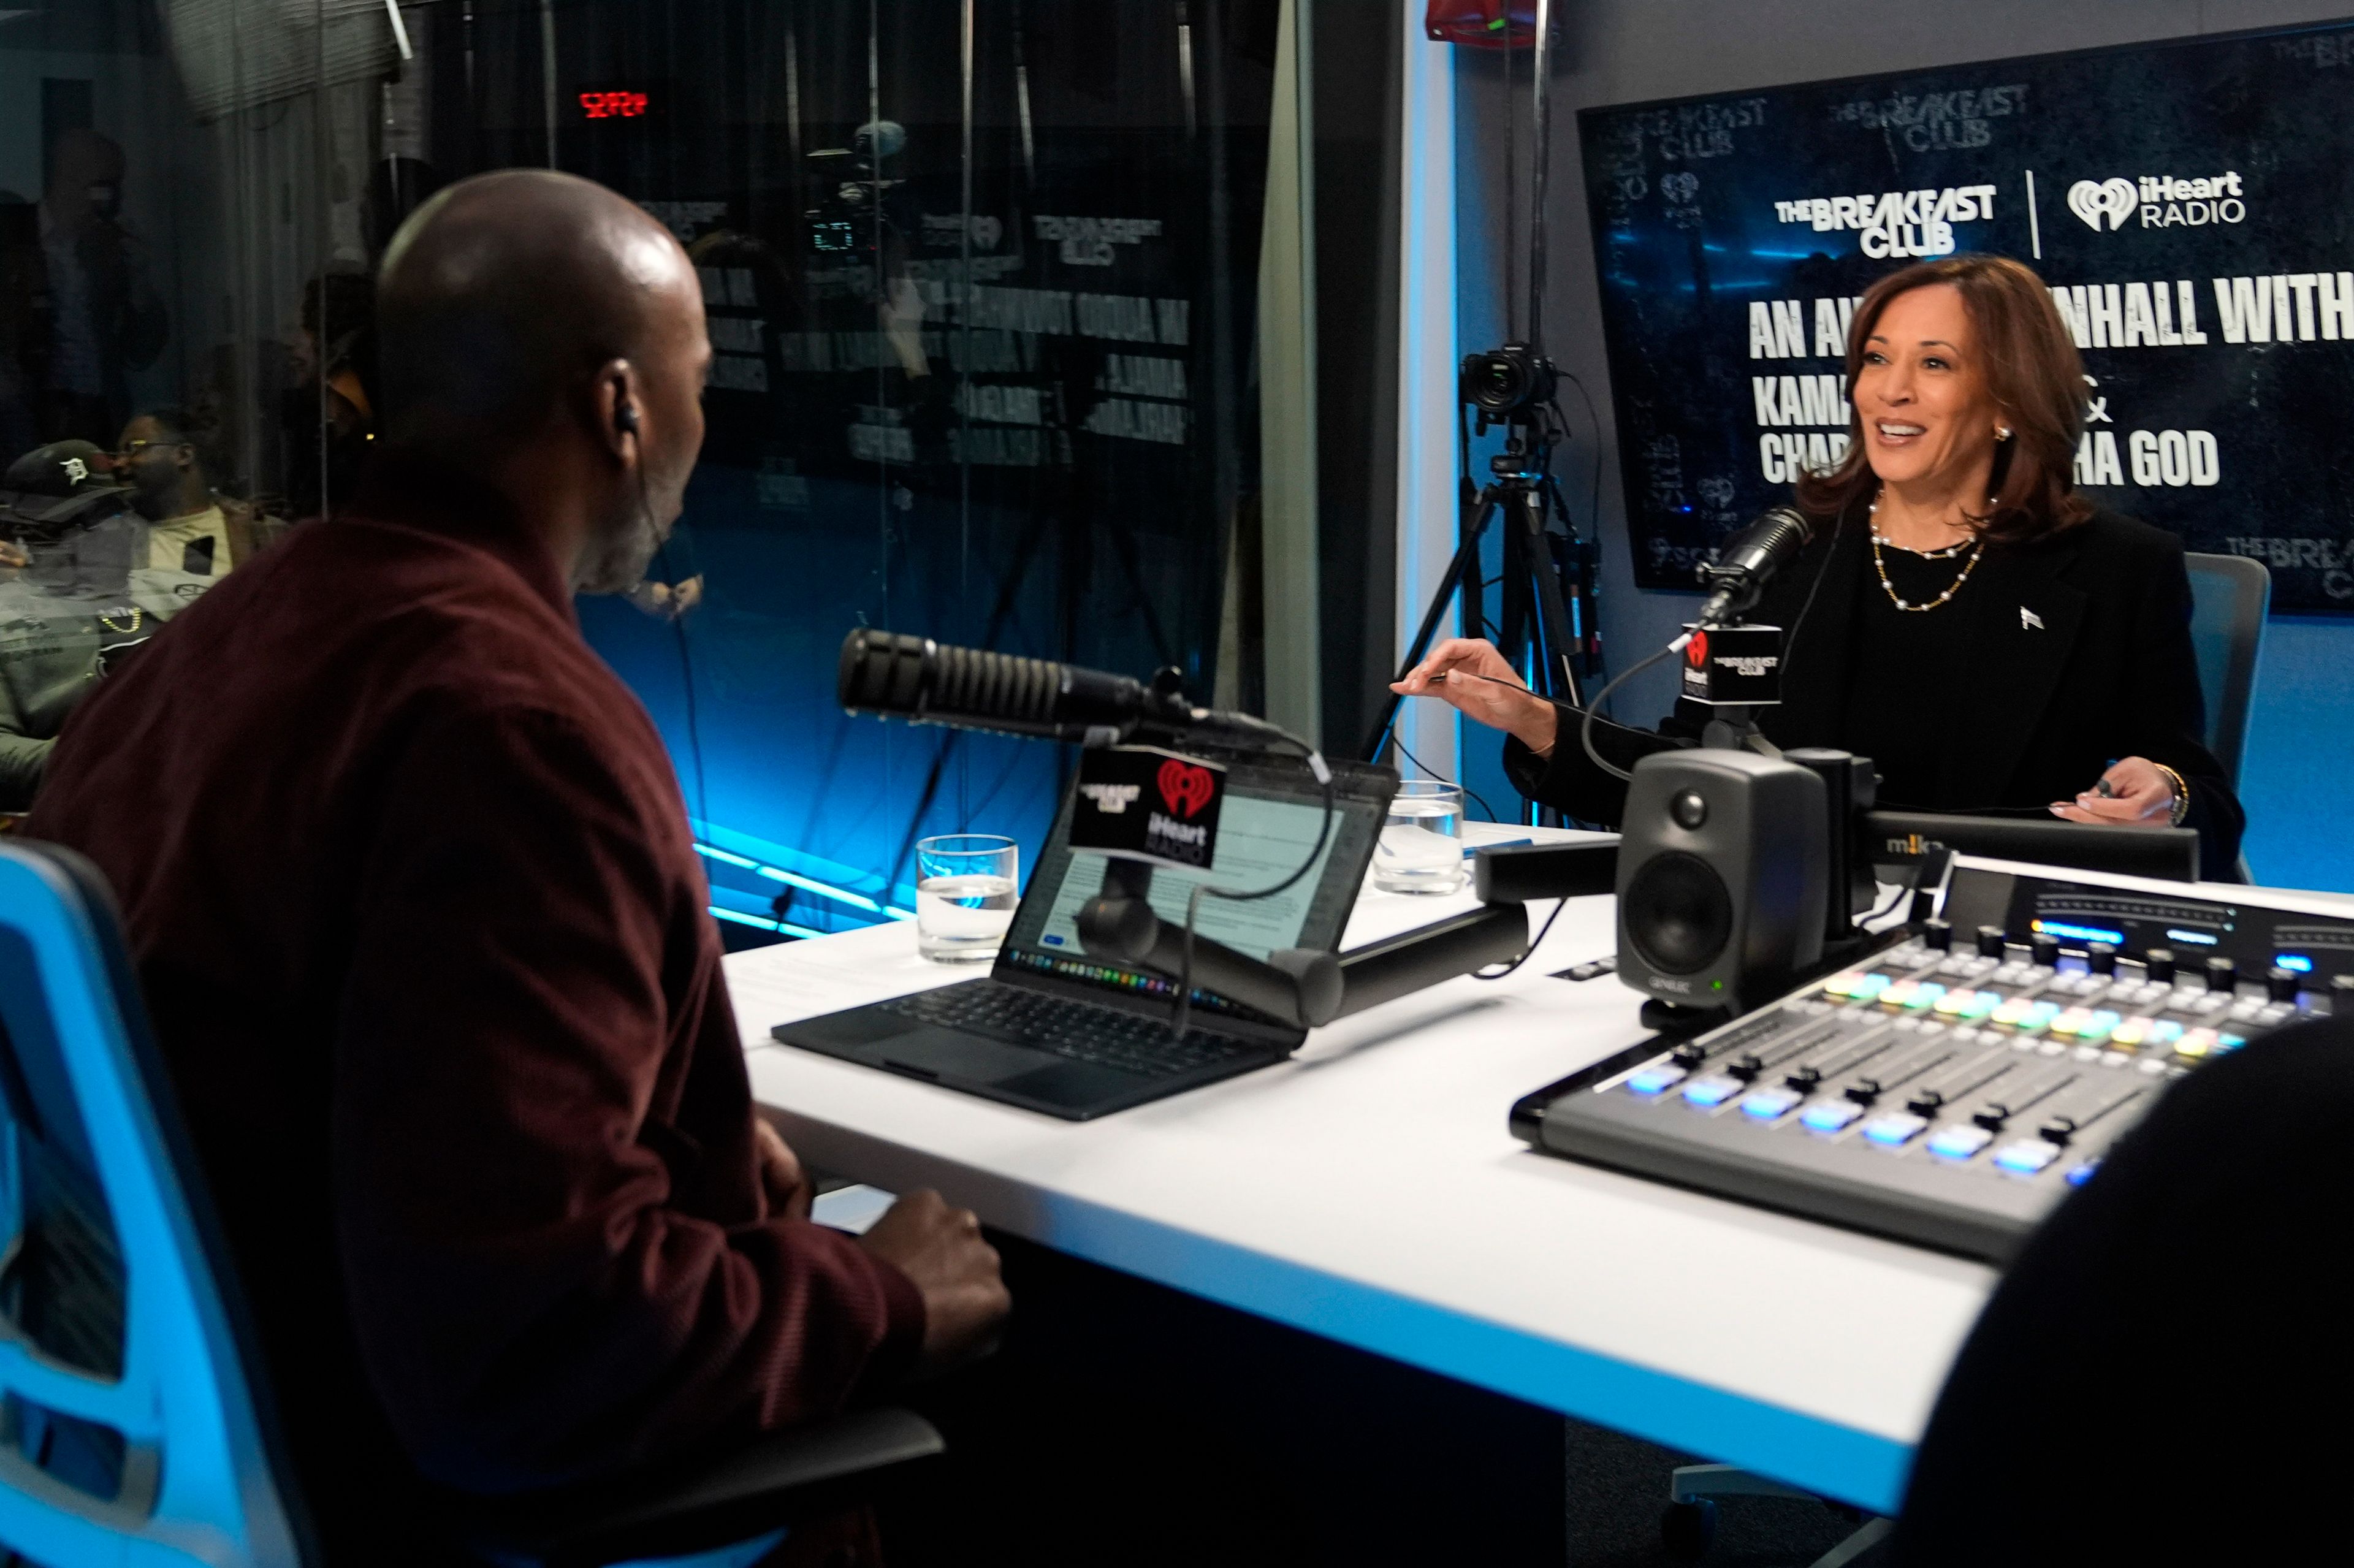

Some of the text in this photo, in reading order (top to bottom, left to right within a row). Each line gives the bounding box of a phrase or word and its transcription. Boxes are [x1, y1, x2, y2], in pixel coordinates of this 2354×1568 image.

[1810, 184, 1997, 232] BREAKFAST
[2138, 170, 2244, 203] iHeart
[2140, 197, 2246, 229] RADIO
[1859, 219, 1956, 259] CLUB
[1749, 299, 1807, 359] AN
[2212, 271, 2354, 344] WITH
[2129, 429, 2220, 487] GOD
